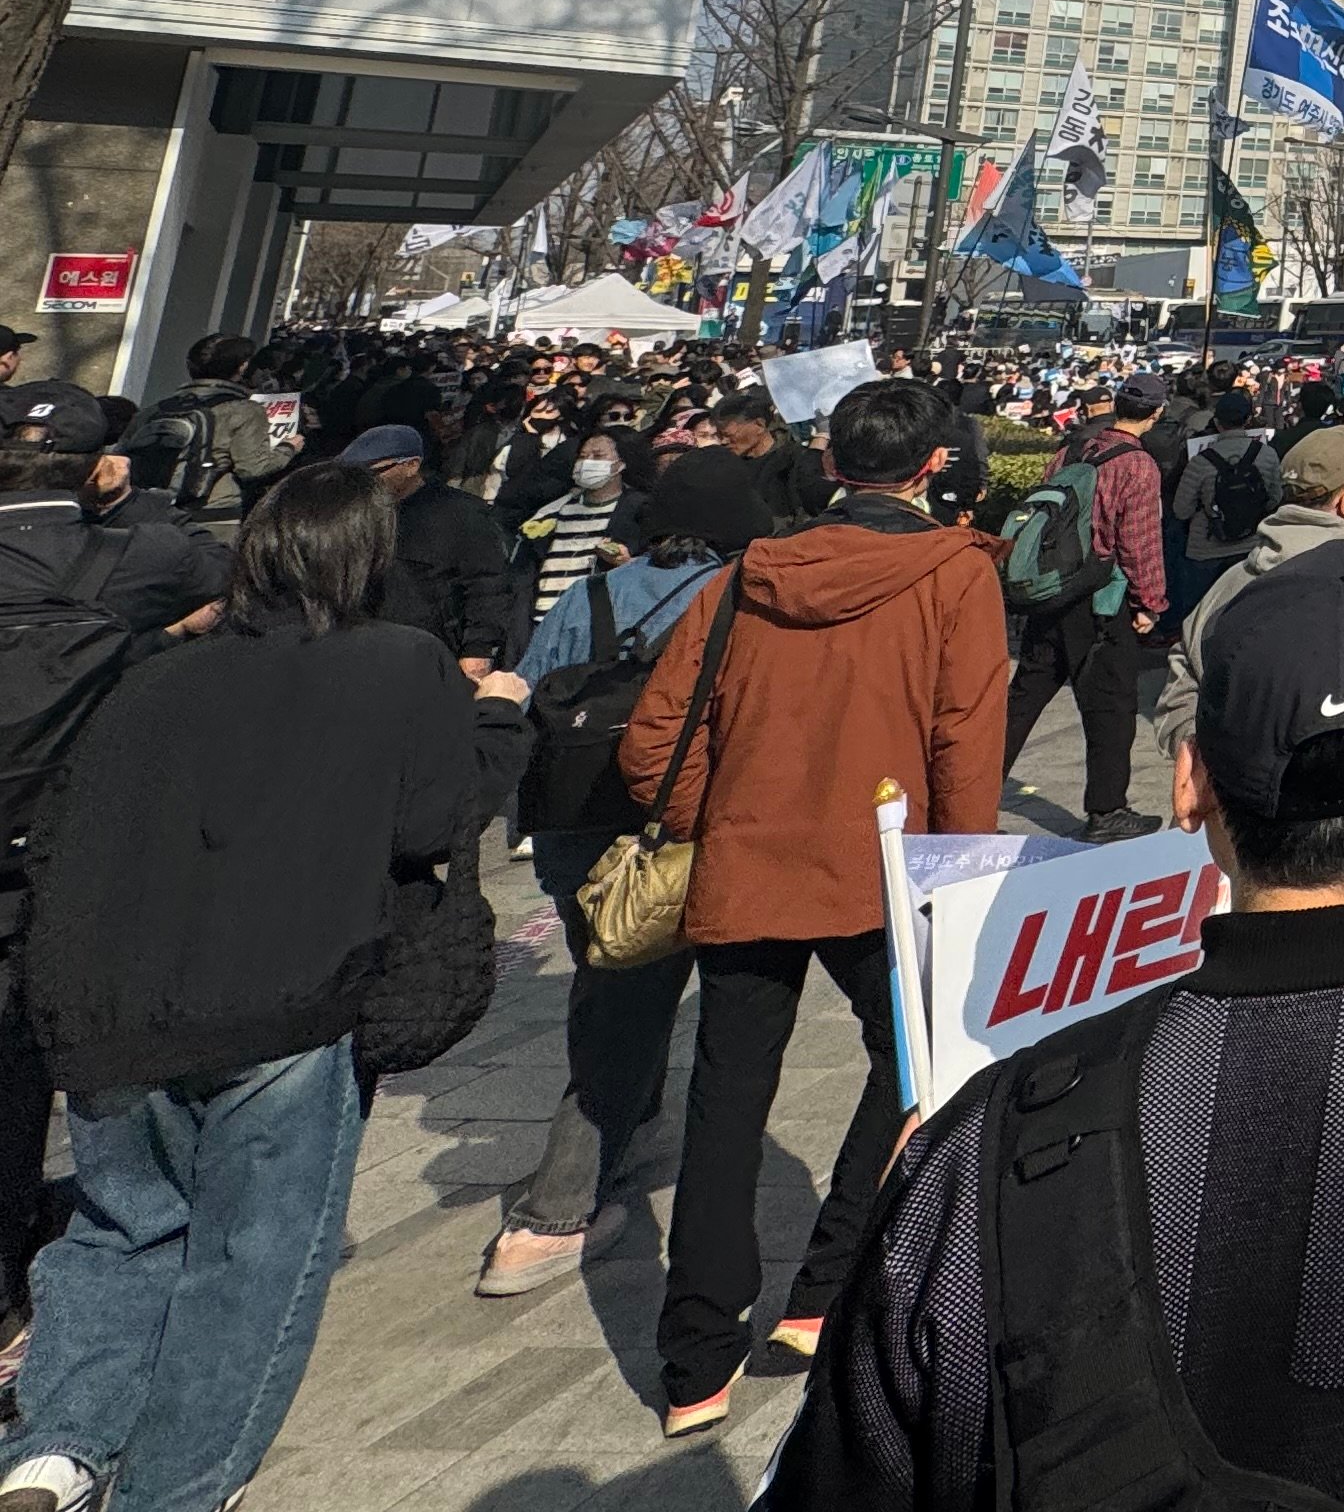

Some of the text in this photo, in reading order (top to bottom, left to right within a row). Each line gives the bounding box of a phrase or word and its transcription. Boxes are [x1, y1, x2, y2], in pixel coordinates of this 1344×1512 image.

[1261, 76, 1296, 113] 경기도
[58, 269, 119, 287] 에스원
[984, 862, 1223, 1030] 내란
